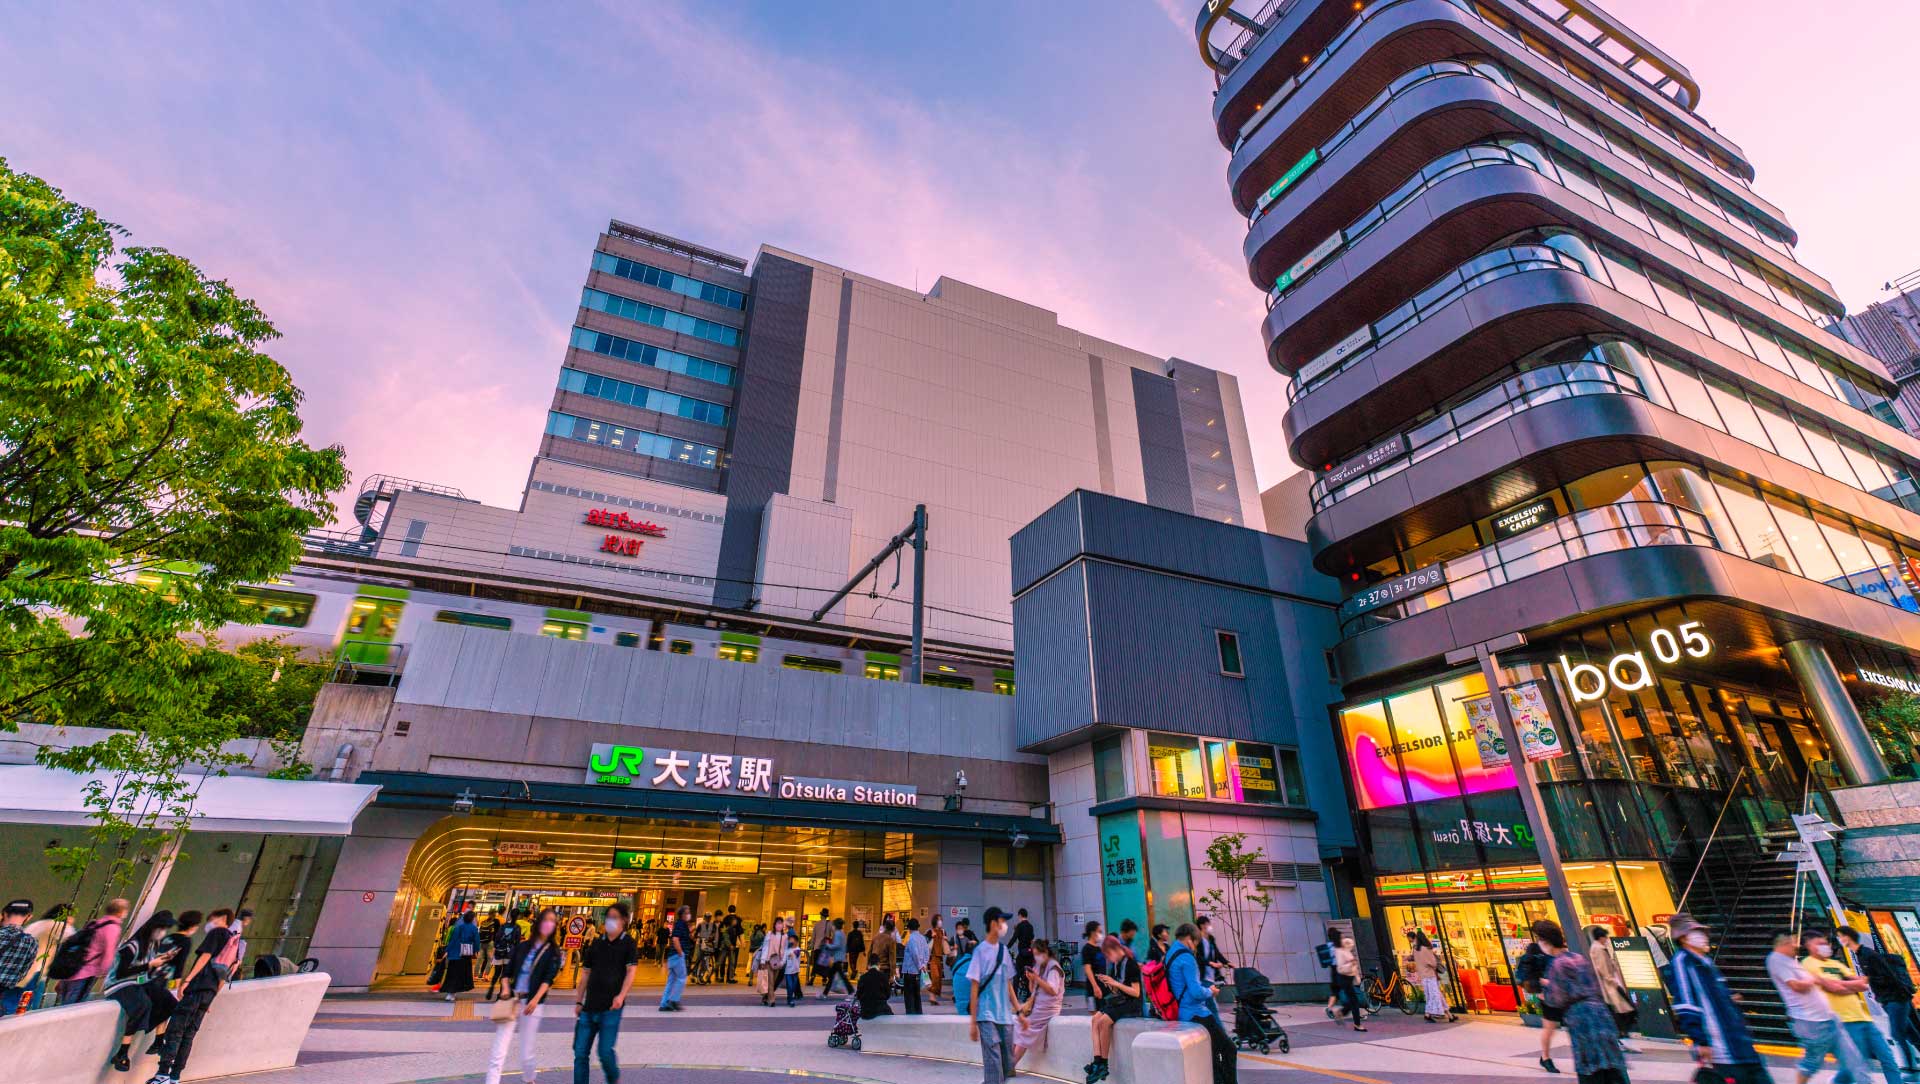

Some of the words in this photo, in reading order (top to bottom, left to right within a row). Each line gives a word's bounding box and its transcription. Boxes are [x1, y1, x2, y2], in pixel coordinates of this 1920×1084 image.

[1498, 504, 1545, 528] EXCELSIOR
[1509, 514, 1538, 532] CAFFÉ
[1368, 590, 1379, 602] 37
[1404, 575, 1417, 589] 77
[1859, 668, 1911, 692] EXCELSIOR
[1375, 735, 1443, 758] EXCELSIOR
[1447, 728, 1475, 744] CAF
[591, 745, 644, 776] JR
[652, 750, 772, 793] 大塚駅
[854, 785, 917, 806] Station
[1104, 834, 1120, 852] JR
[629, 854, 646, 865] JR
[656, 856, 698, 869] 大塚駅
[1105, 858, 1137, 877] 大塚駅
